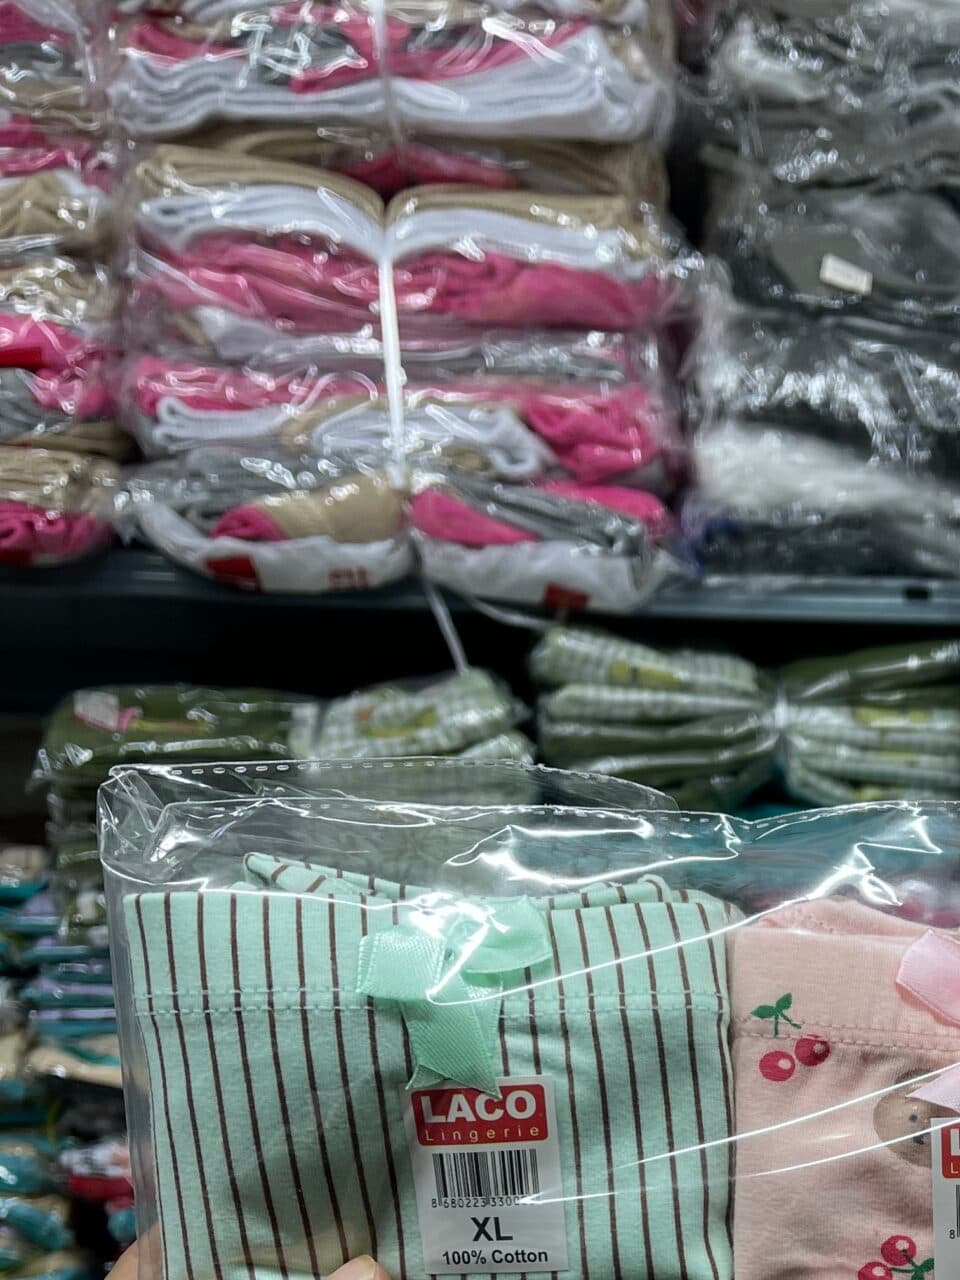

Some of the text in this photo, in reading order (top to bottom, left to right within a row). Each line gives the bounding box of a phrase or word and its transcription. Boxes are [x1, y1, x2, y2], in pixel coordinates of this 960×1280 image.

[420, 1090, 536, 1124] LACO
[424, 1125, 539, 1143] Lingerie
[471, 1217, 513, 1242] XL
[442, 1249, 548, 1265] 100% Cotton
